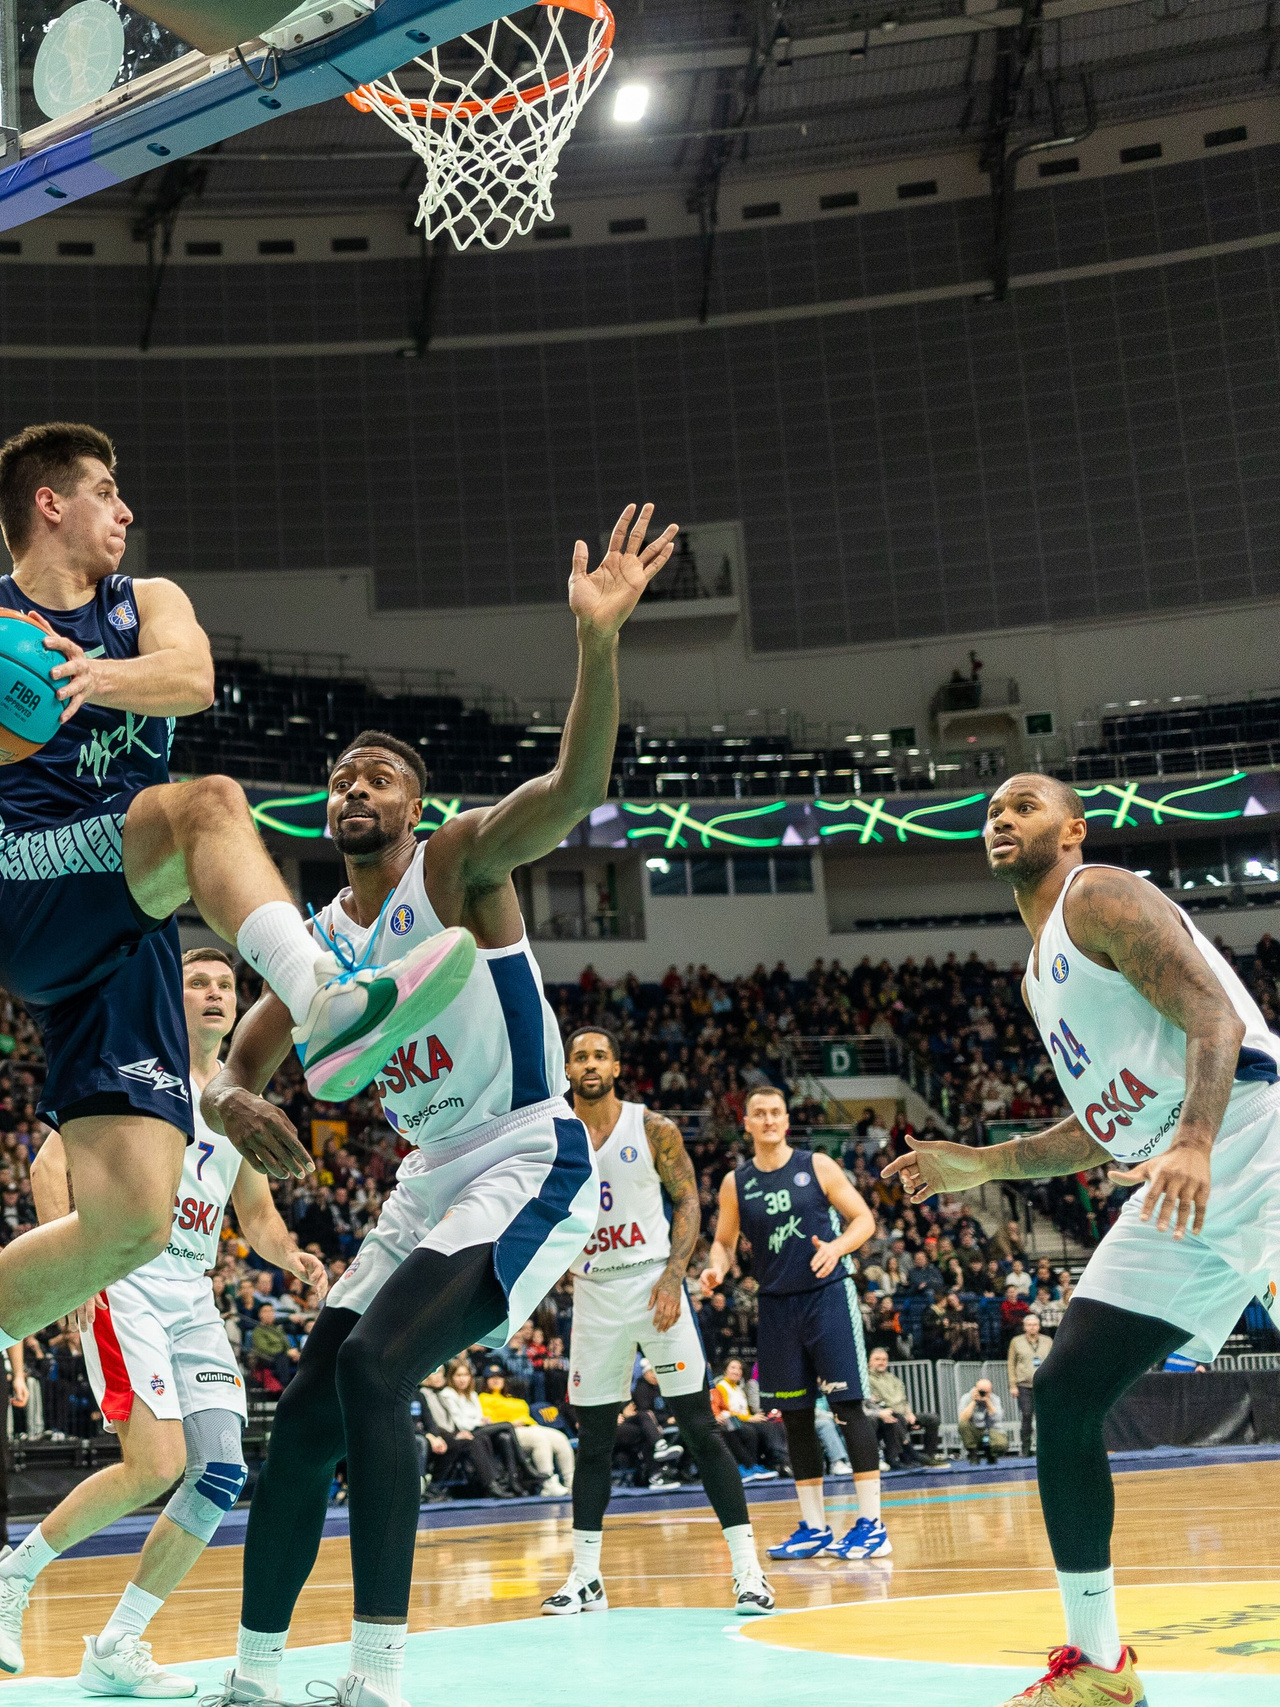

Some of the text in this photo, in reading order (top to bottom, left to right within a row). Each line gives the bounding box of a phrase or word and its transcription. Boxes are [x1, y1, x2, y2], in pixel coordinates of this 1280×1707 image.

[4, 695, 32, 718] APPROVED
[10, 680, 41, 711] FIBA
[830, 1051, 850, 1073] D
[1050, 1018, 1091, 1080] 24
[378, 1034, 453, 1098] SKA
[1085, 1068, 1159, 1143] CSKA
[197, 1140, 215, 1181] 7
[764, 1189, 792, 1215] 38
[583, 1222, 646, 1255] CSKA
[198, 1372, 234, 1383] Winline
